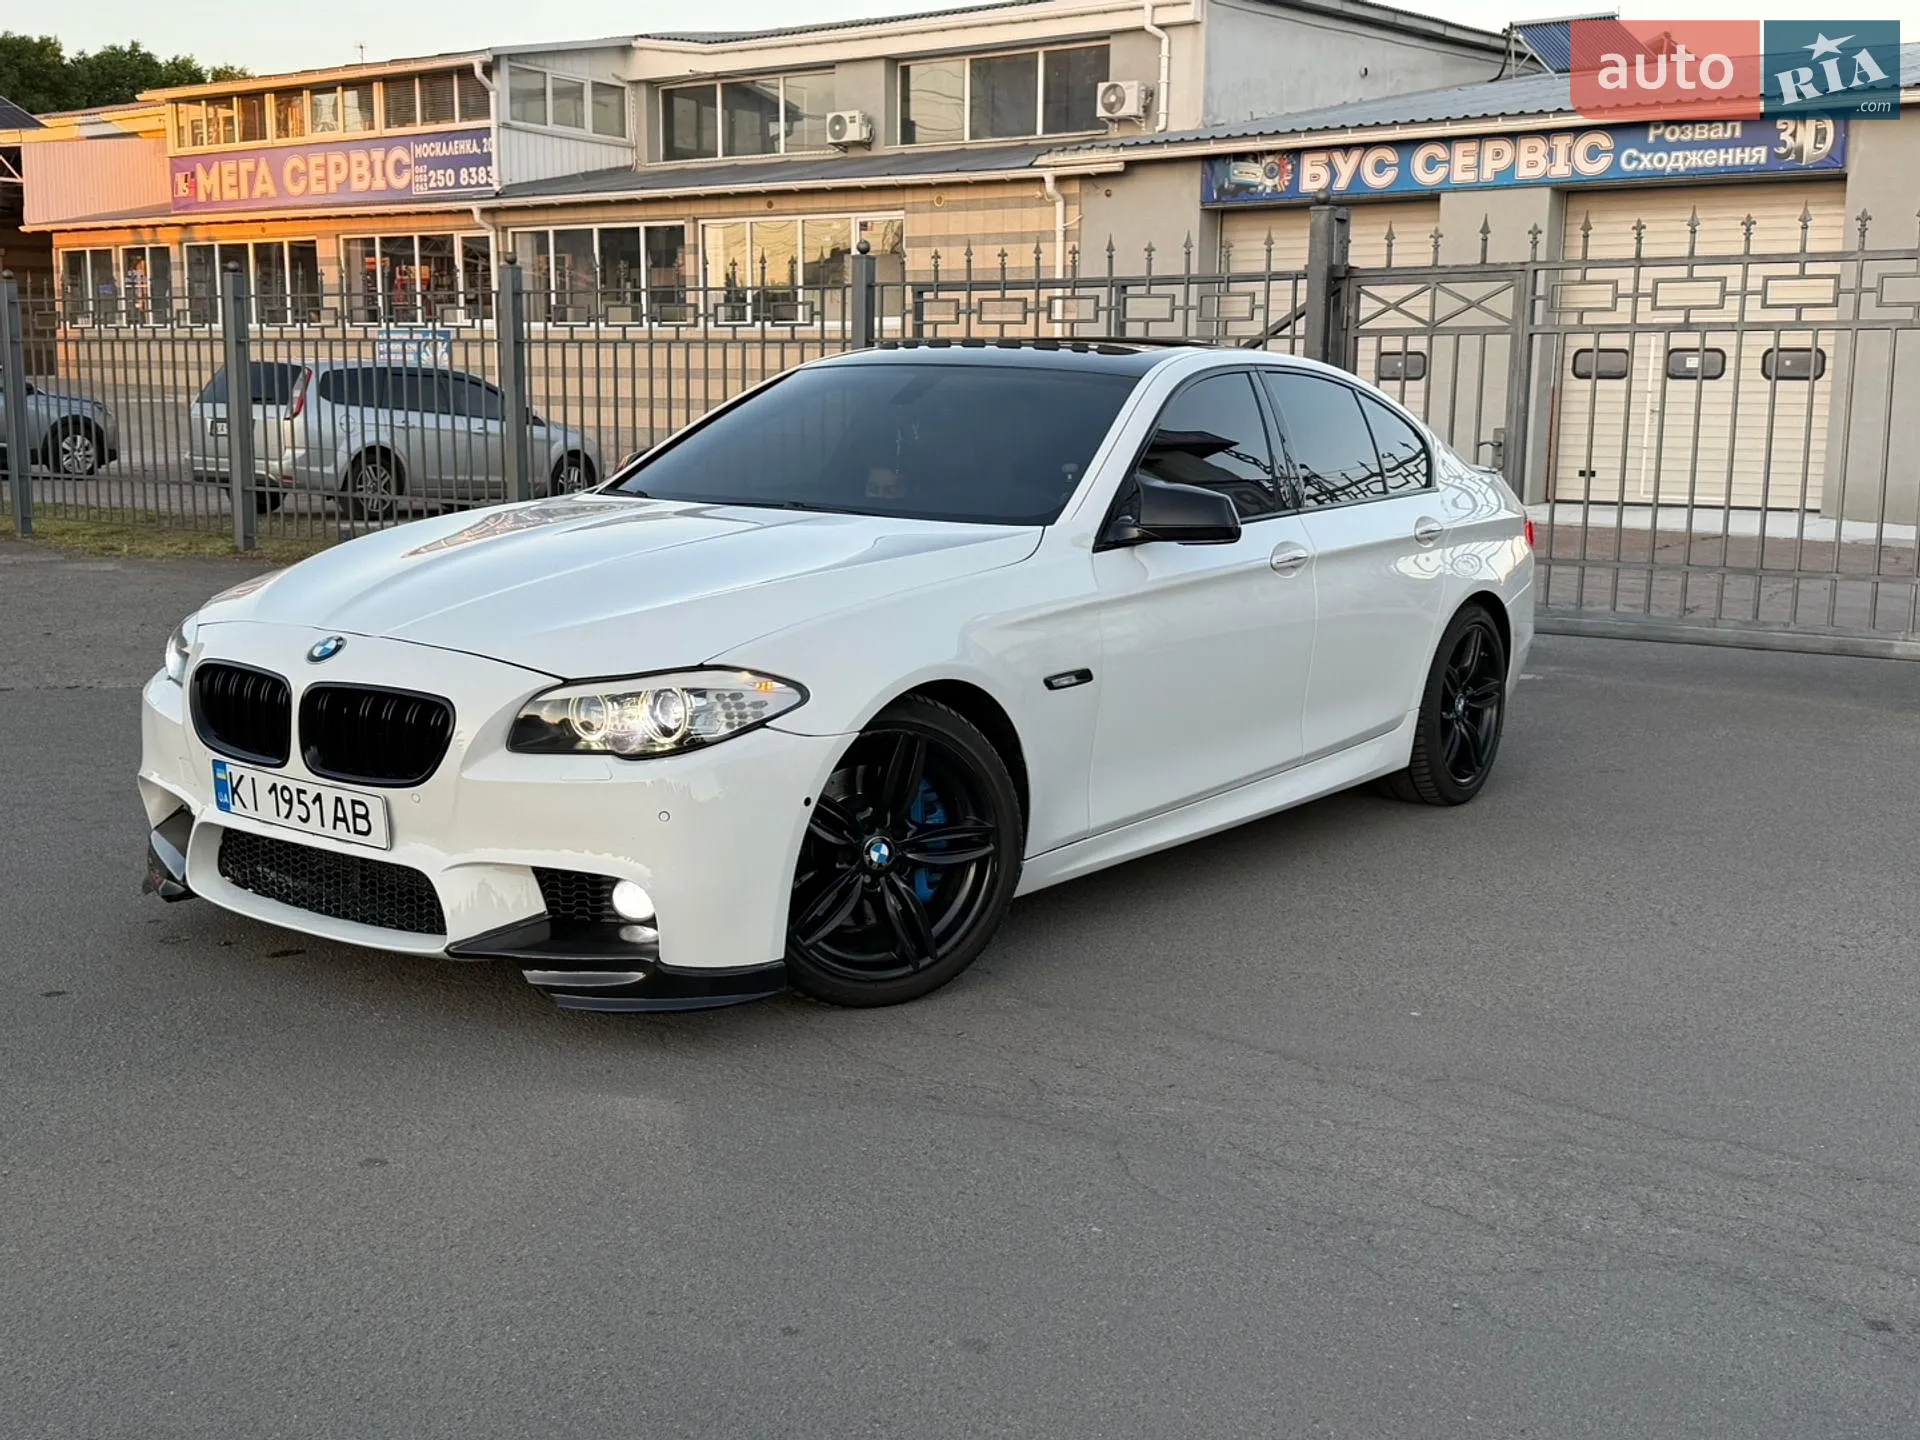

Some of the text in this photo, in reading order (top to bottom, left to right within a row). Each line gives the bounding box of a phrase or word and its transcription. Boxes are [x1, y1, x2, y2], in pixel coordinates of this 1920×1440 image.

[1648, 120, 1742, 143] Розвал
[1774, 112, 1835, 165] 3D
[195, 157, 278, 203] МЕГА
[282, 145, 412, 197] СЕРВІС
[428, 168, 455, 188] 250
[1299, 130, 1615, 193] БУС СЕРВІС
[1620, 145, 1768, 172] Сходження
[229, 772, 372, 836] KI 1951 AB
